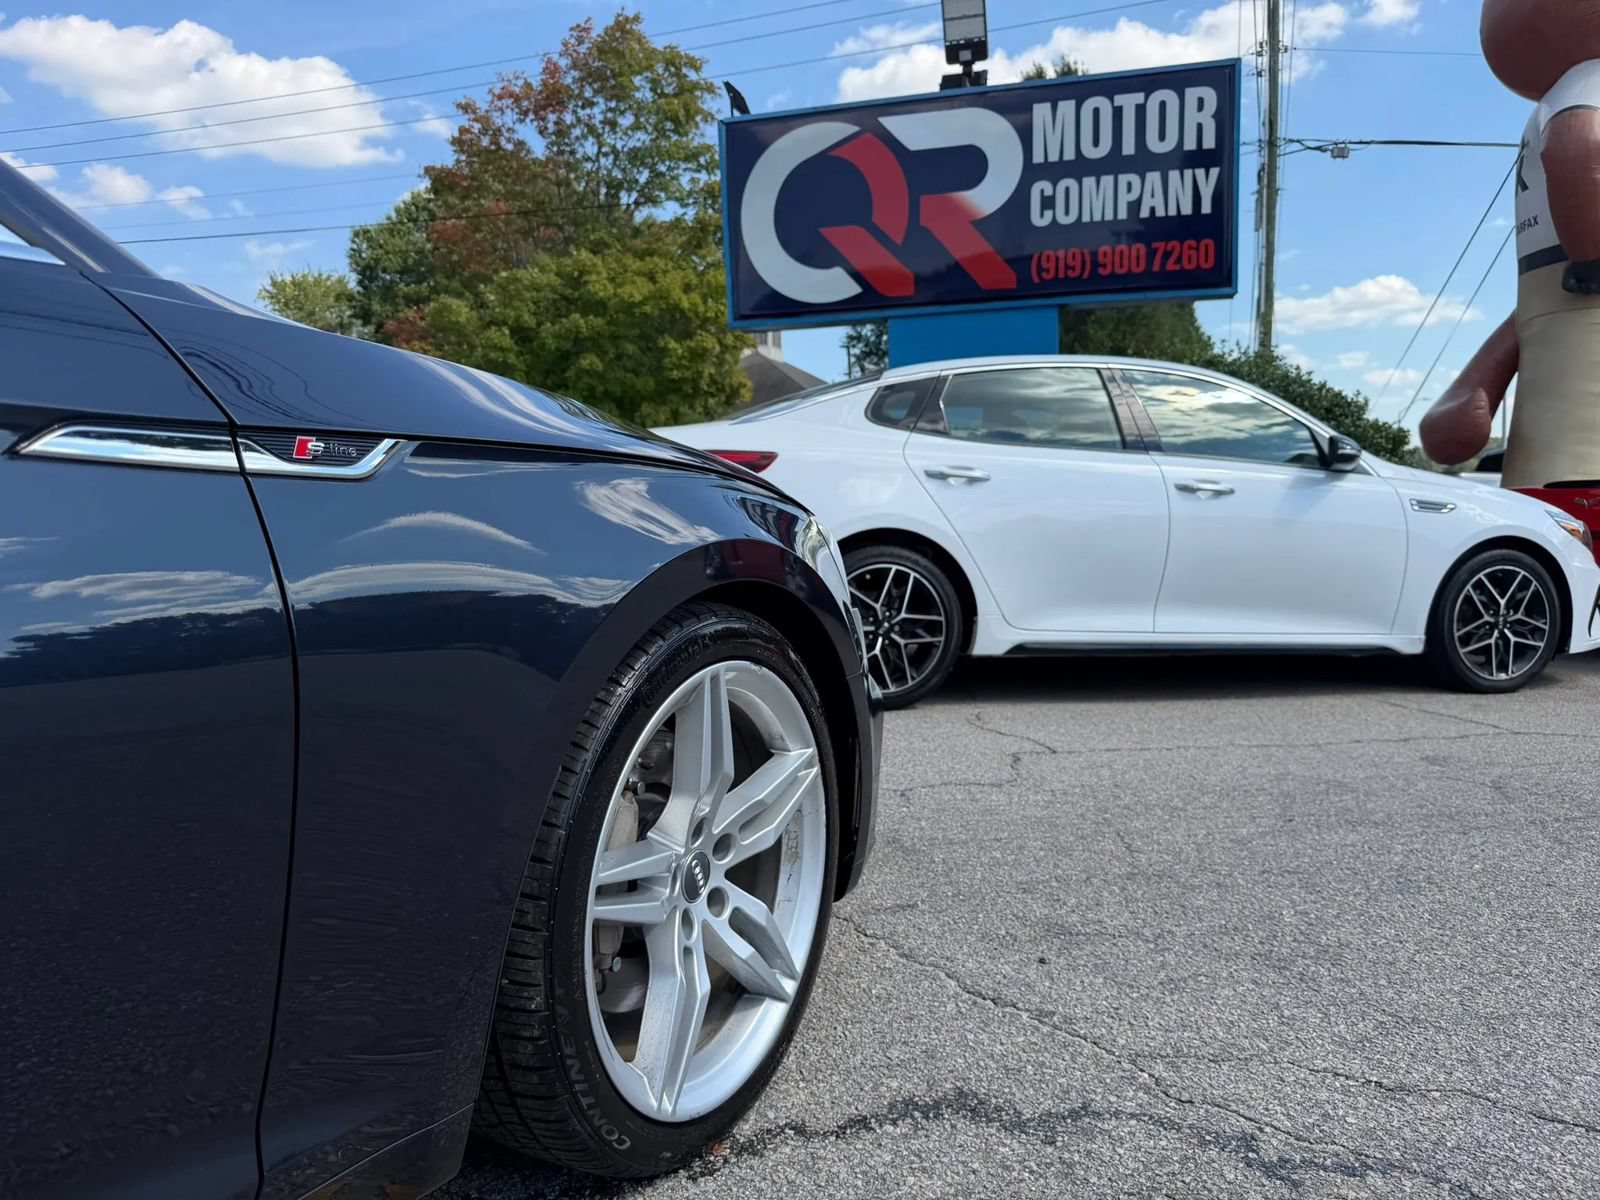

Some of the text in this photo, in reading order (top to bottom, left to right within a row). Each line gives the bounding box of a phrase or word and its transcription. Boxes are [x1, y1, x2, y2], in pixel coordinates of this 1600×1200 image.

[1031, 86, 1218, 164] MOTOR
[740, 106, 1024, 304] QR
[1029, 167, 1221, 228] COMPANY
[1030, 238, 1215, 282] (919) 900 7260
